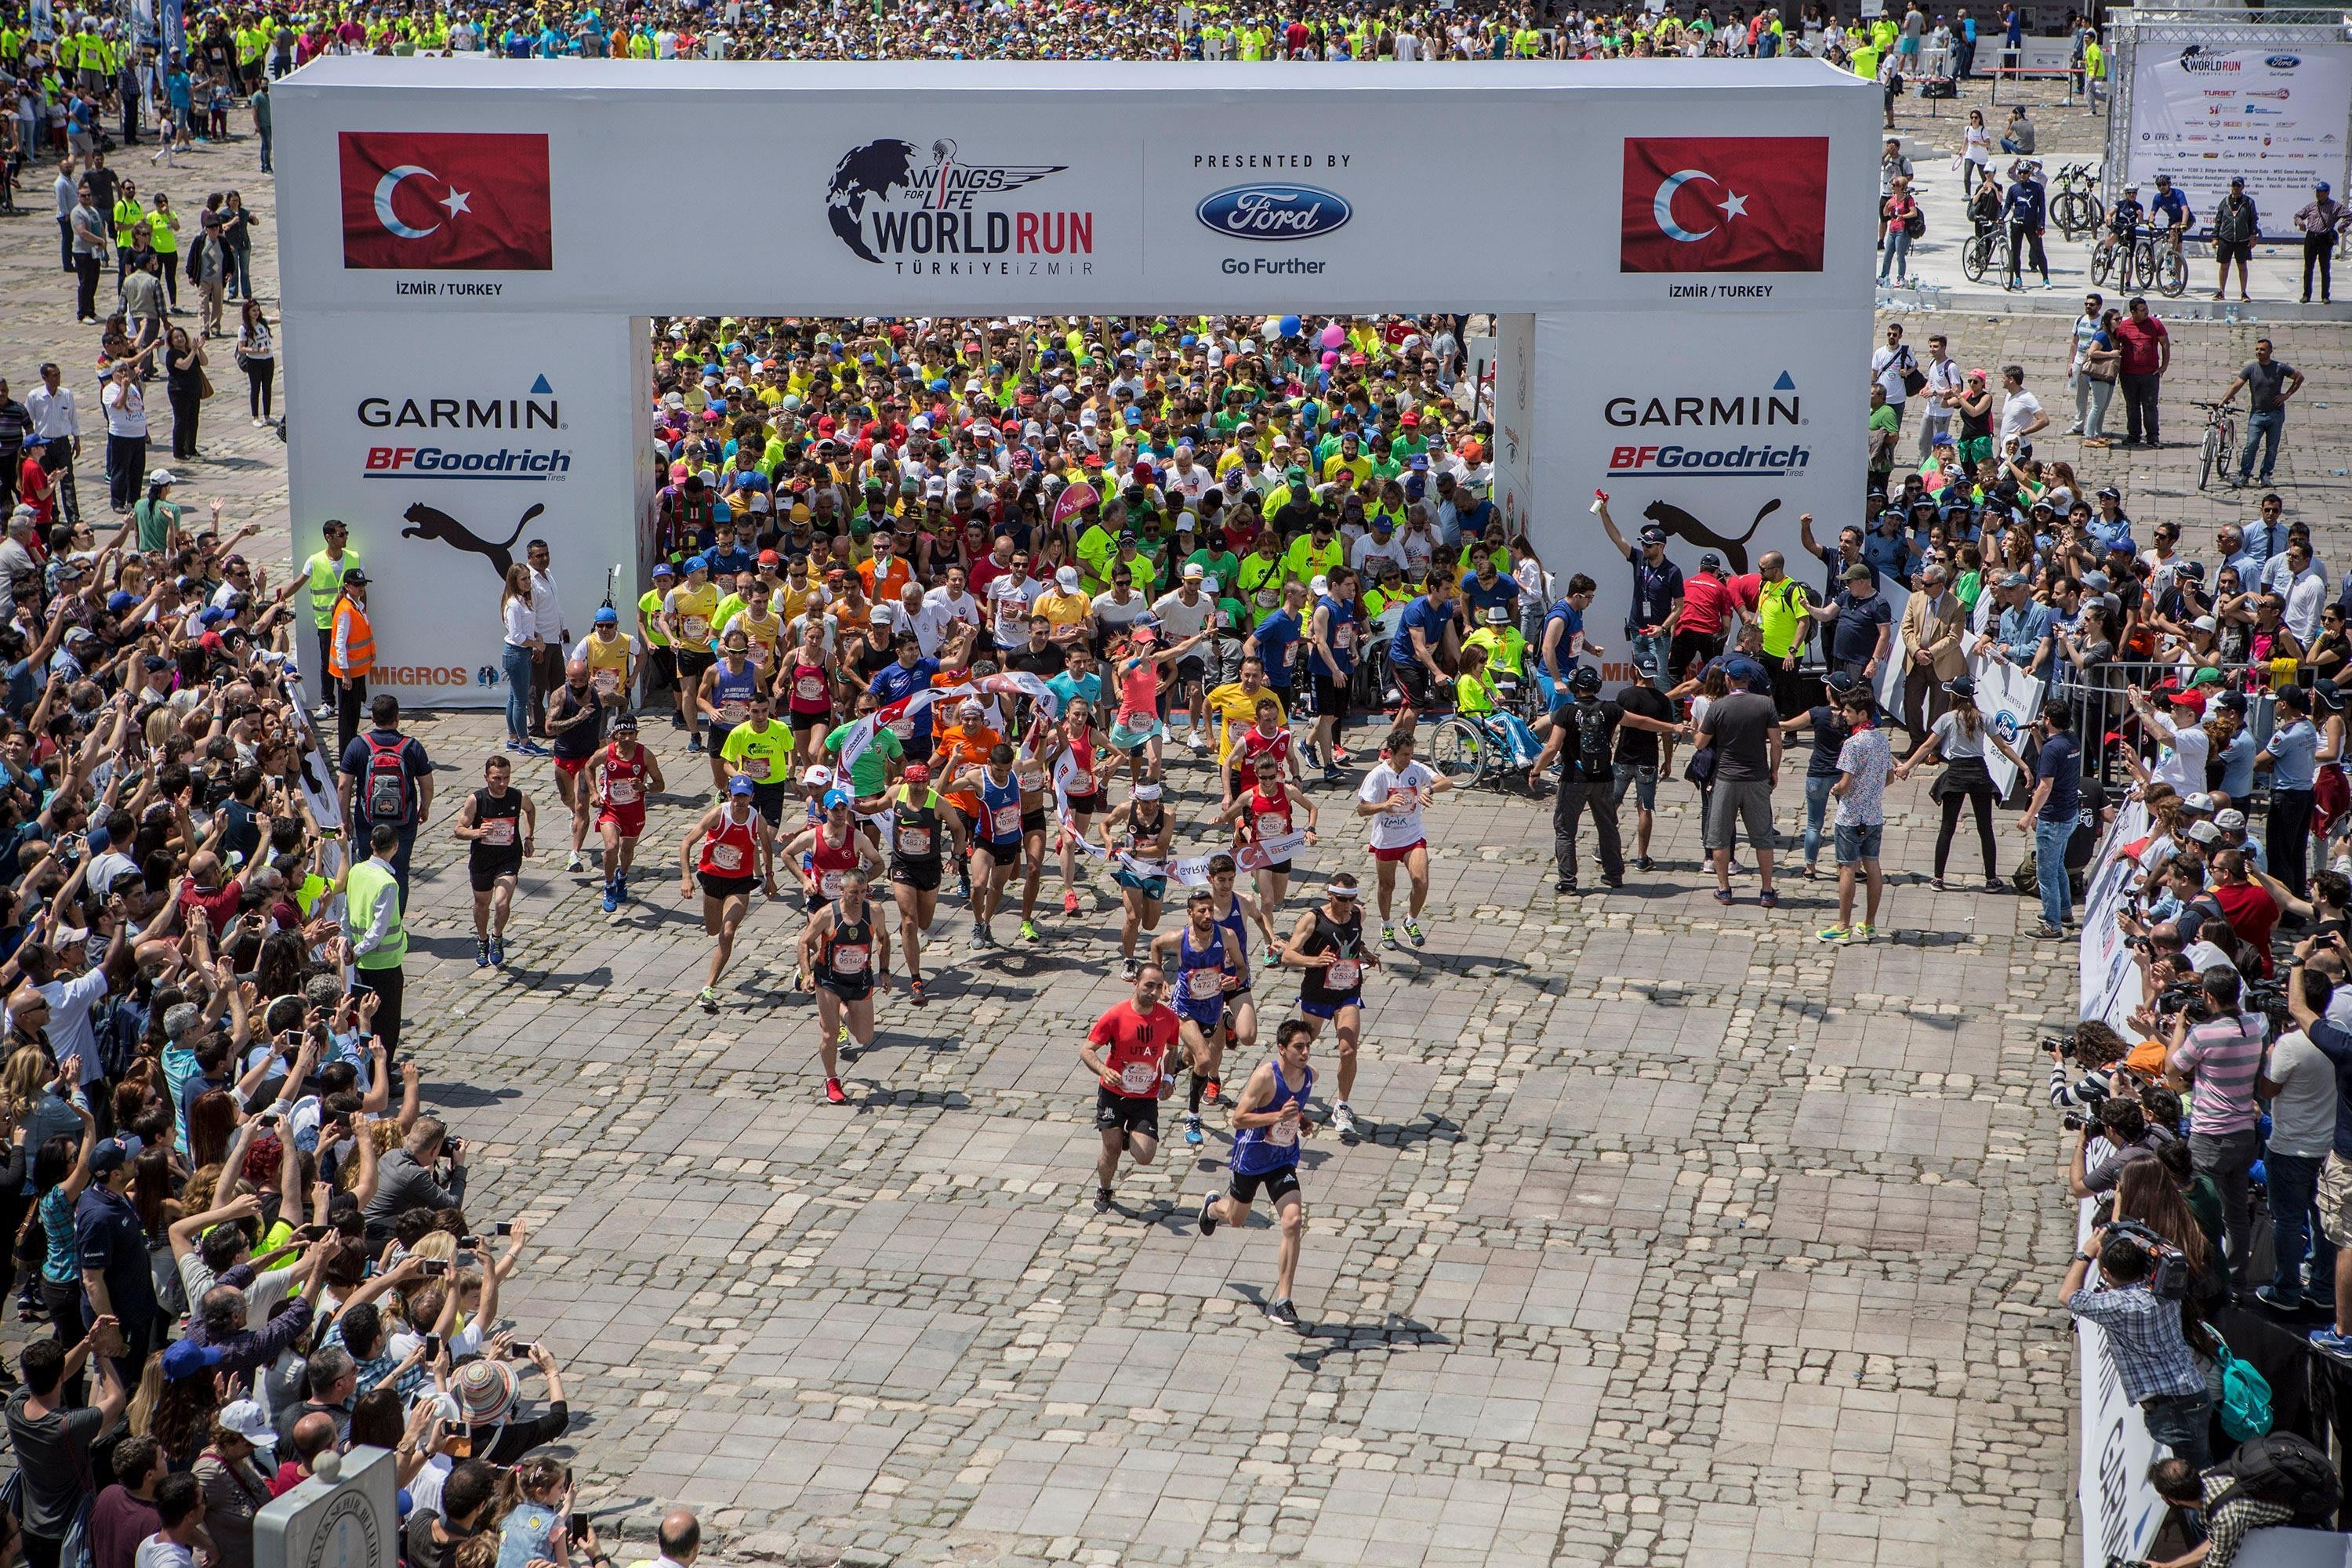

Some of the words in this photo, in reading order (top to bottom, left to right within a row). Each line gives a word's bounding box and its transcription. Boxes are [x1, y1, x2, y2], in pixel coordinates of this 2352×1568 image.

[2190, 61, 2222, 71] WORLD
[2223, 60, 2241, 71] RUN
[2270, 56, 2294, 67] Ford
[1194, 154, 1319, 168] PRESENTED
[1328, 154, 1352, 168] BY
[904, 191, 924, 199] FOR
[1227, 194, 1319, 228] Ford
[873, 211, 1010, 254] WORLD
[1016, 211, 1093, 254] RUN
[1221, 259, 1250, 274] Go
[1254, 257, 1327, 274] Further
[396, 281, 437, 295] İZMİR
[447, 283, 503, 296] TURKEY
[1669, 283, 1708, 298] İZMİR
[1719, 285, 1773, 298] TURKEY
[358, 397, 558, 430] GARMIN
[1604, 396, 1800, 427] GARMIN
[365, 447, 571, 472] BFGoodrich
[1609, 445, 1810, 469] BFGoodrich
[546, 473, 566, 482] Tires
[1784, 468, 1805, 477] Tires
[690, 507, 699, 520] 11
[799, 684, 818, 692] 95197
[2001, 689, 2021, 710] PRESENTED
[1998, 714, 2016, 741] Ford
[1023, 777, 1042, 787] 5892
[1261, 822, 1282, 831] 52567
[902, 837, 927, 847] 148279
[1330, 971, 1356, 980] 125392
[1192, 978, 1220, 990] 147279
[1124, 1075, 1153, 1083] 121572
